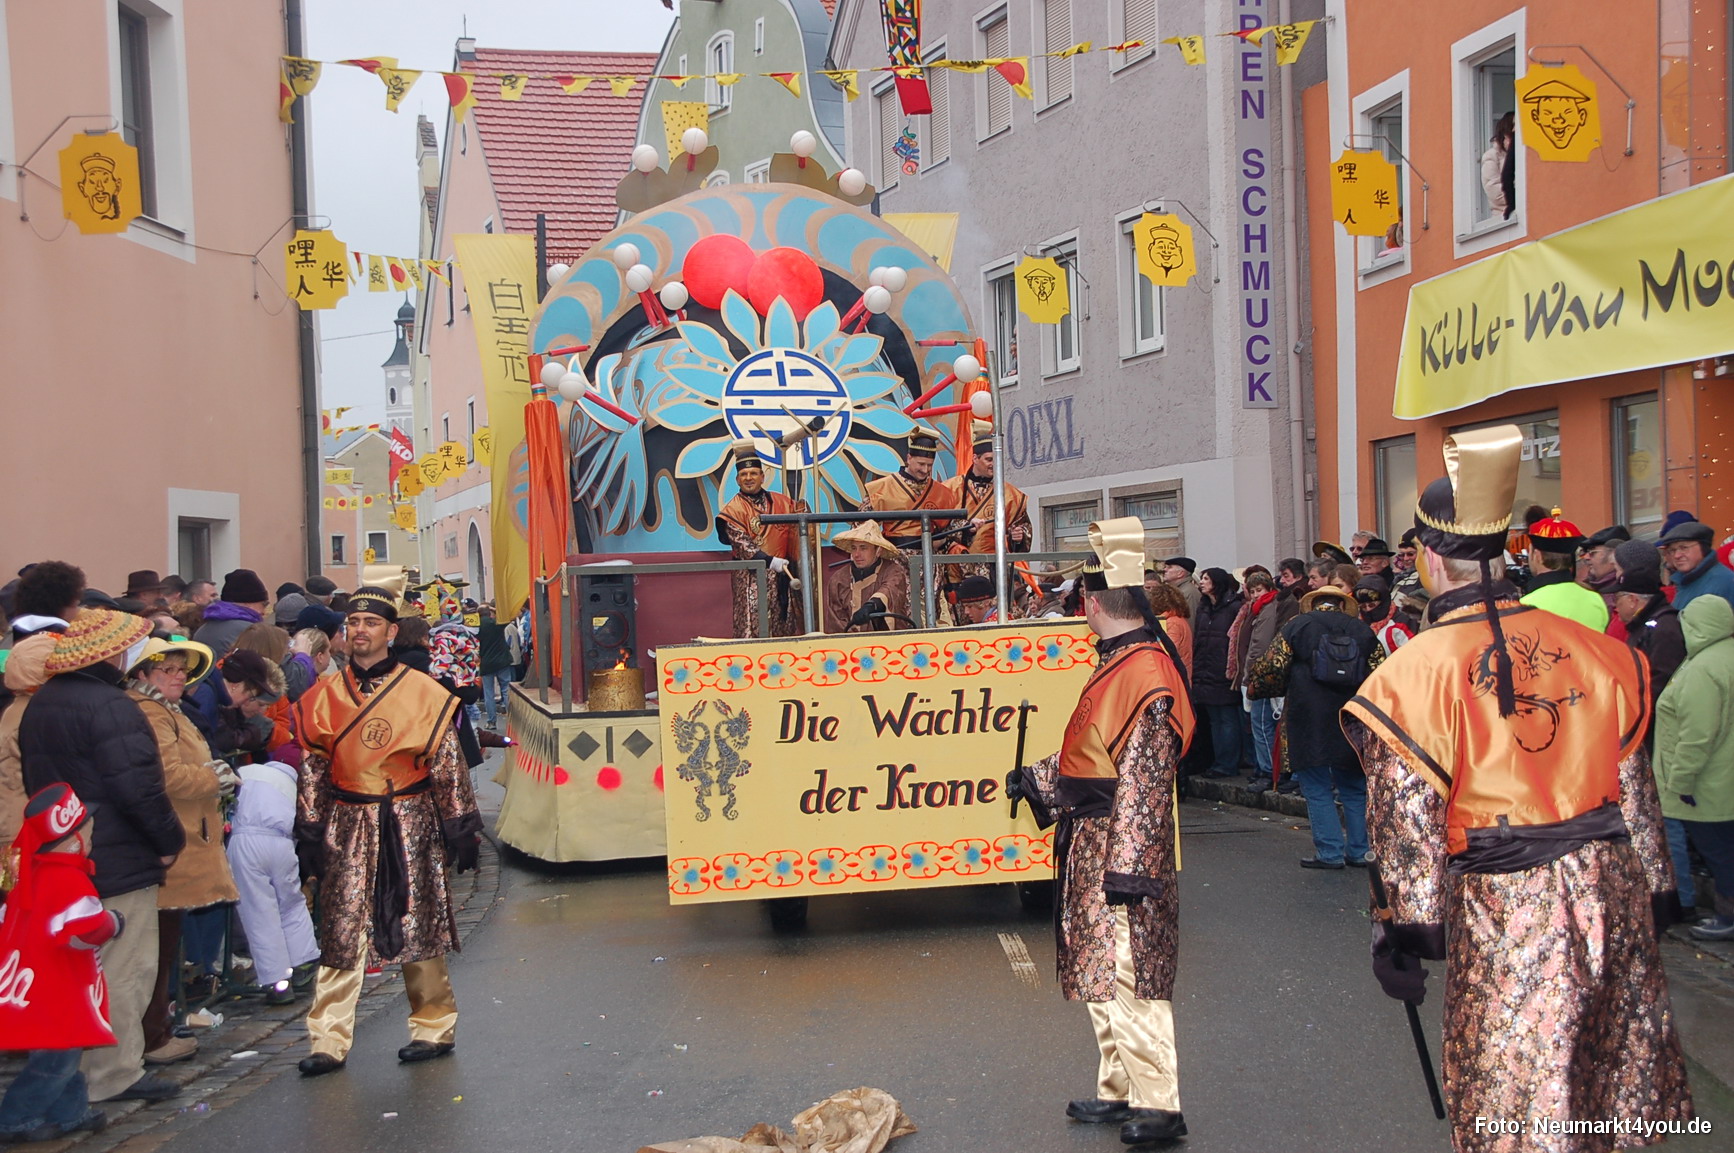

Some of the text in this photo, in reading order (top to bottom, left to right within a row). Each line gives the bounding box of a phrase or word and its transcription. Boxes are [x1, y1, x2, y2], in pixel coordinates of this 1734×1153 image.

[1239, 0, 1264, 119] REN
[1242, 149, 1272, 402] SCHMUCK
[1007, 395, 1084, 469] OEXL
[775, 698, 840, 743] Die
[861, 687, 1038, 738] Wächter
[799, 763, 999, 815] der Krone
